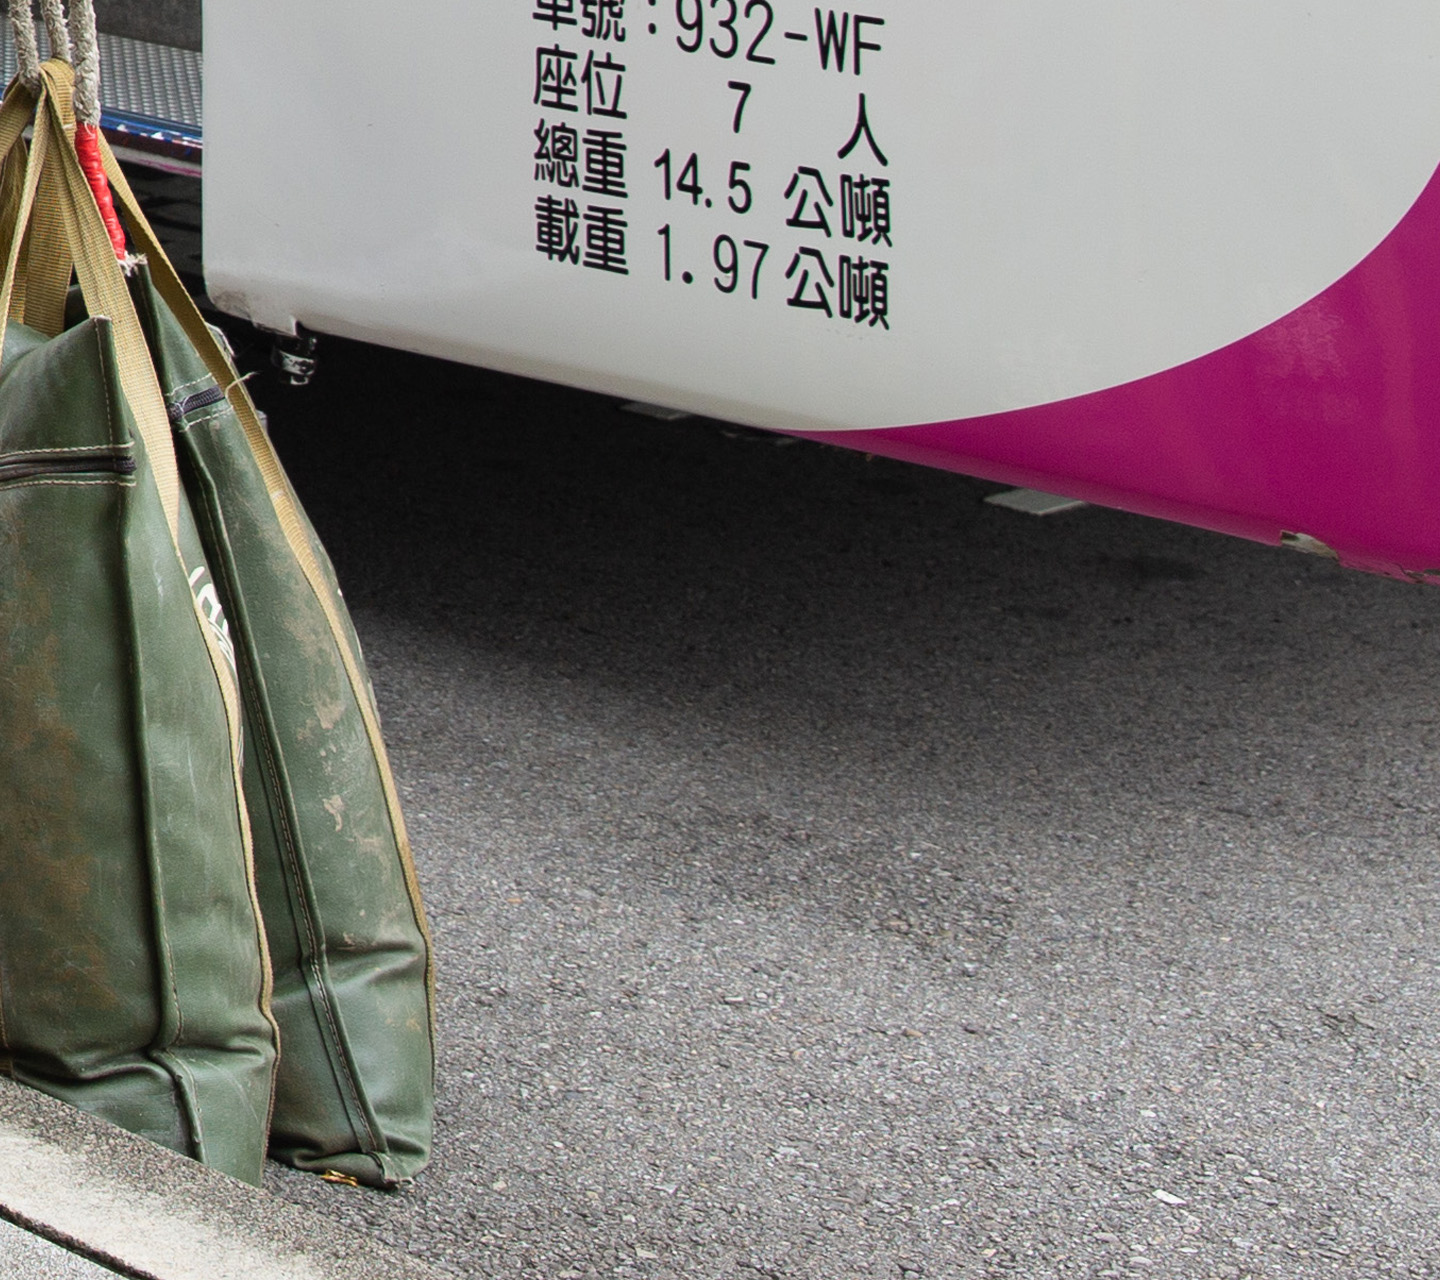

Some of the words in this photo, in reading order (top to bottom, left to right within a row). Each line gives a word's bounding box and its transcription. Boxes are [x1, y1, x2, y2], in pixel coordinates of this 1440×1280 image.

[533, 43, 628, 120] 座位
[726, 80, 753, 134] 7
[836, 90, 889, 167] 人
[533, 118, 629, 200] 總重
[652, 148, 754, 216] 14.5
[783, 165, 893, 249] 公噸
[534, 194, 630, 278] 載重
[655, 222, 770, 301] 1.97
[784, 244, 892, 332] 公噸
